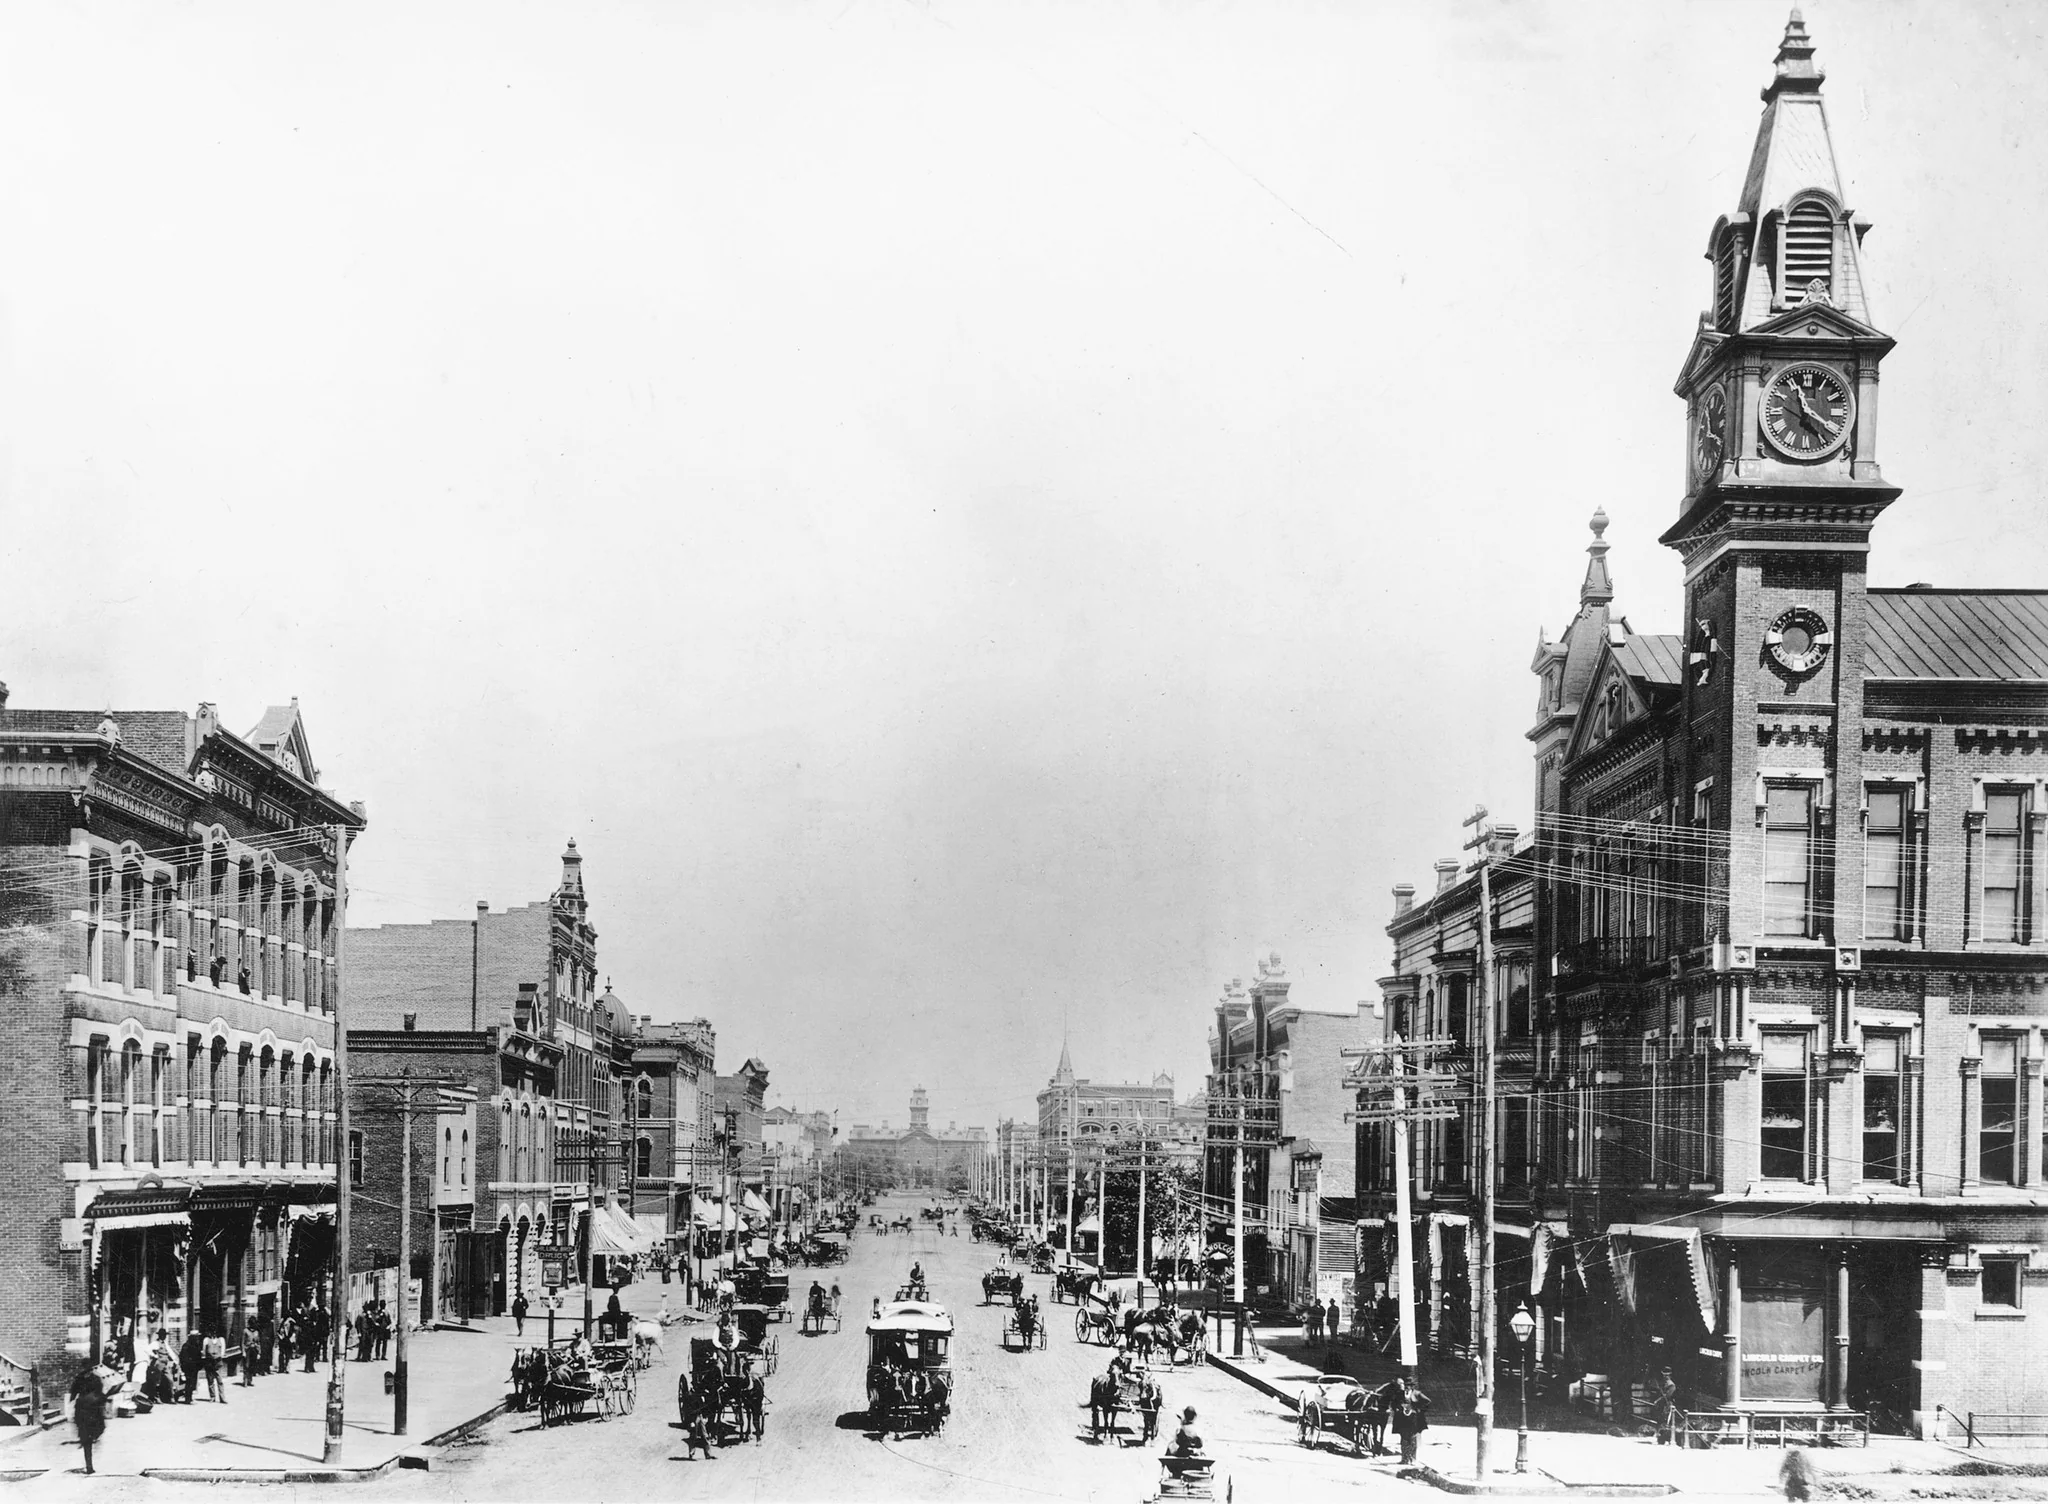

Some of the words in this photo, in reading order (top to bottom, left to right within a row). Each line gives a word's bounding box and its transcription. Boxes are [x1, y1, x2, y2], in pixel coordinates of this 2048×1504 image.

[1803, 374, 1812, 387] XII
[1742, 1354, 1777, 1362] LINCOLN
[1778, 1354, 1810, 1362] CARPET
[1774, 1366, 1805, 1375] CARPET
